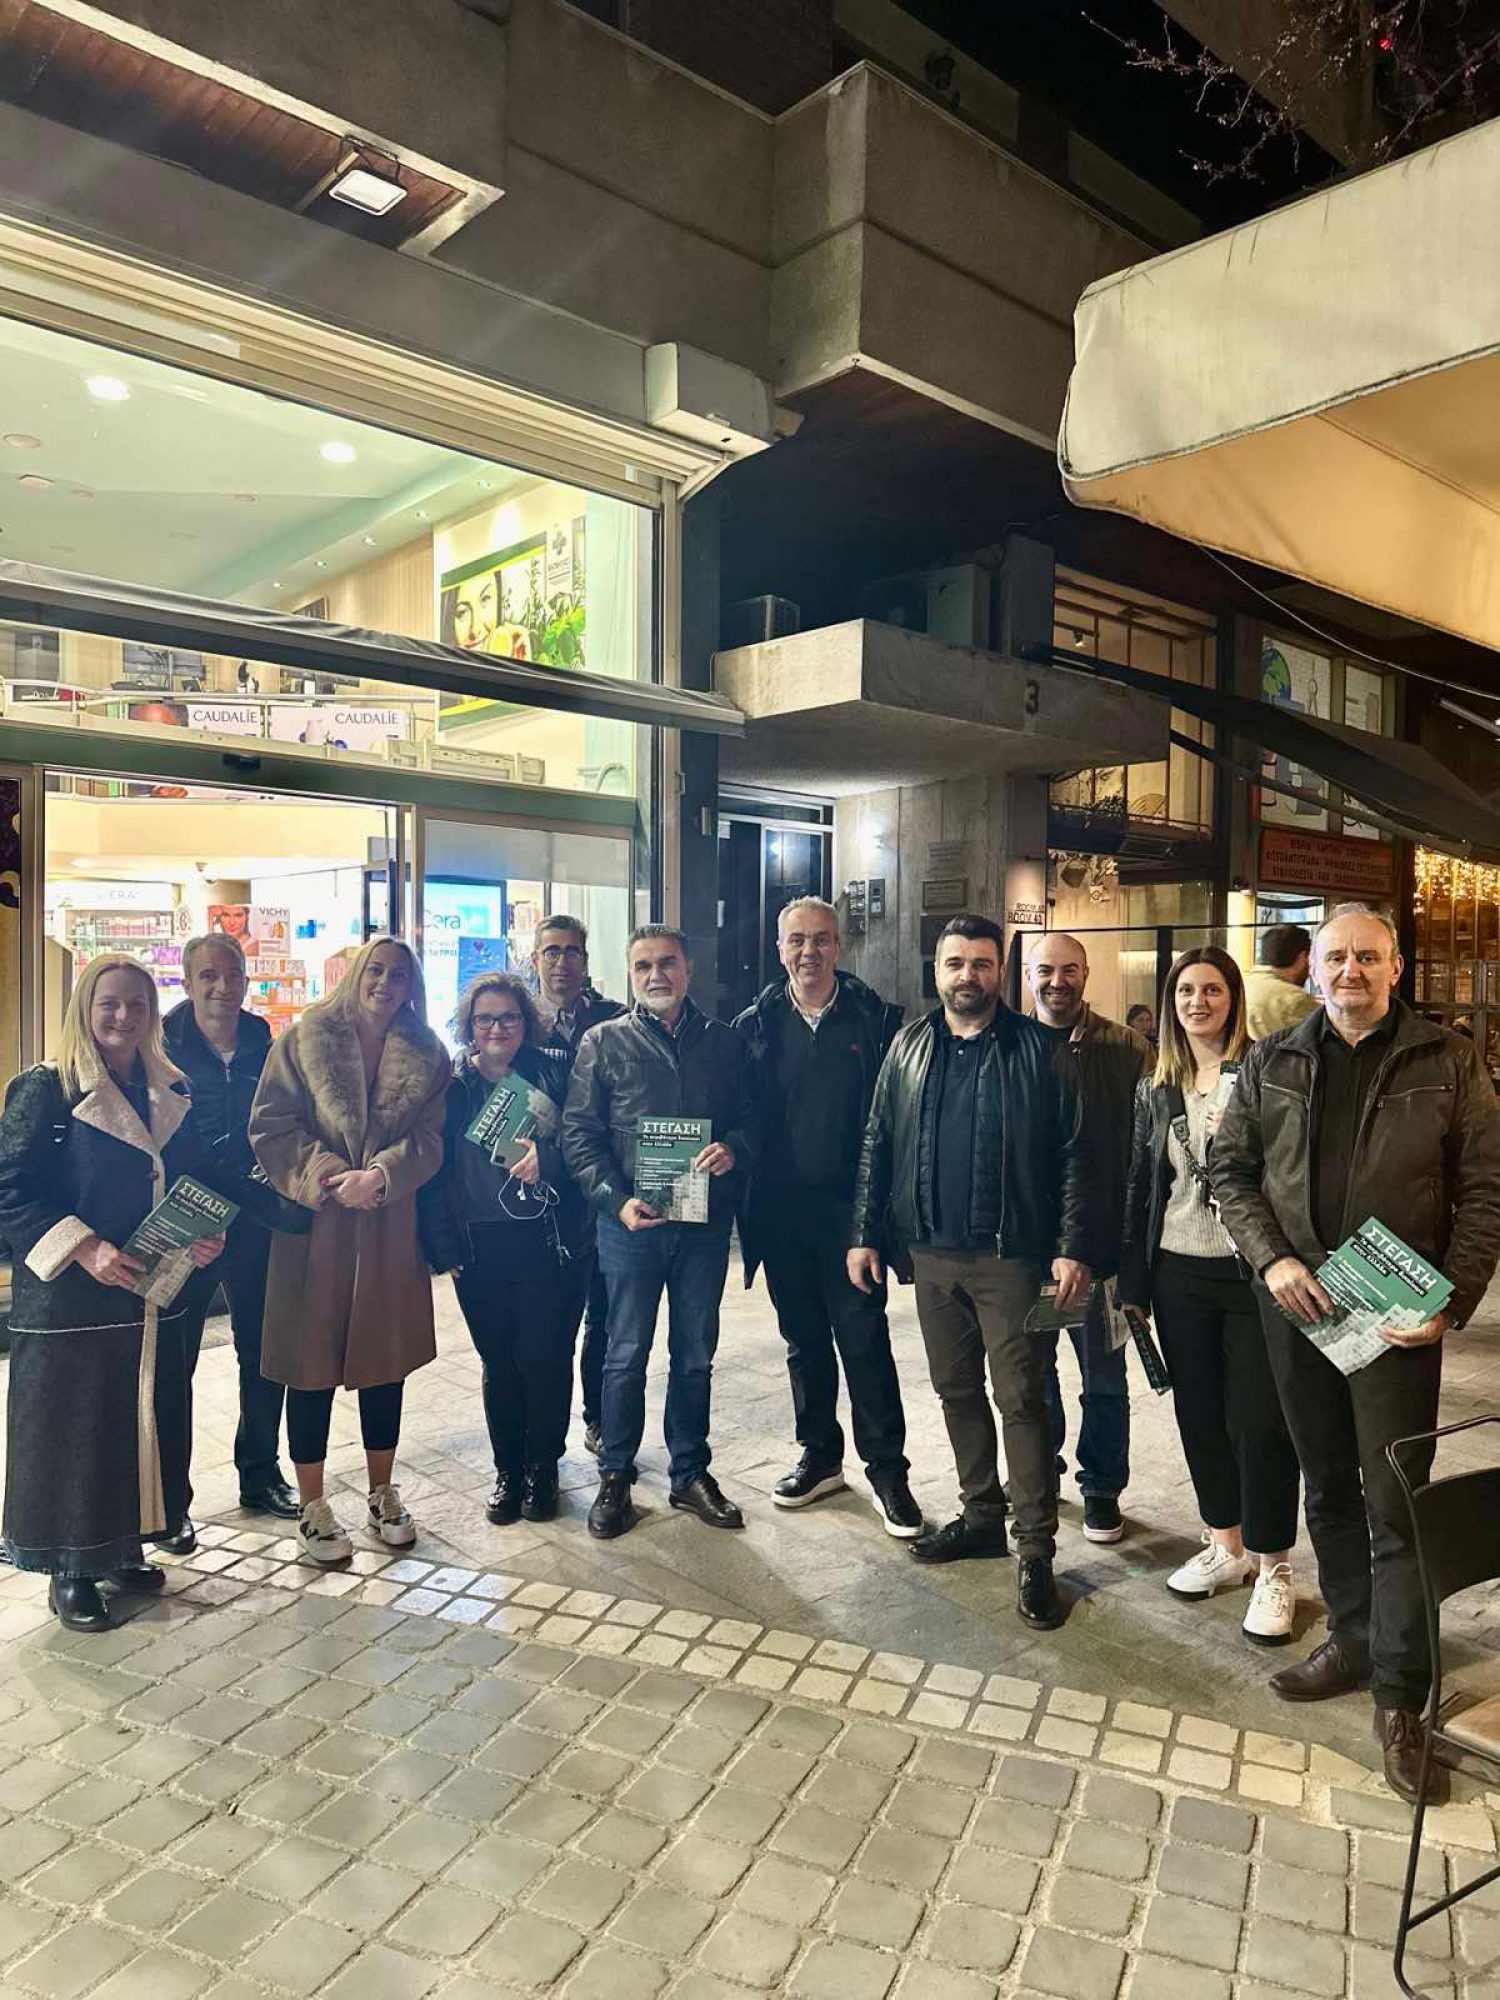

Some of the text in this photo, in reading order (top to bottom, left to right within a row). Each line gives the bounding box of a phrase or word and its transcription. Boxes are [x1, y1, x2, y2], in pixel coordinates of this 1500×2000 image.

[1025, 680, 1040, 716] 3
[260, 907, 288, 917] VICHY
[472, 1088, 511, 1138] ΣΤΕΓΑΣΗ
[643, 1122, 701, 1134] ΣΤΕΓΑΣΗ
[180, 1182, 230, 1217] ΣΤΕΓΑΣΗ
[1364, 1225, 1438, 1290] ΣΤΕΓΑΣΗ
